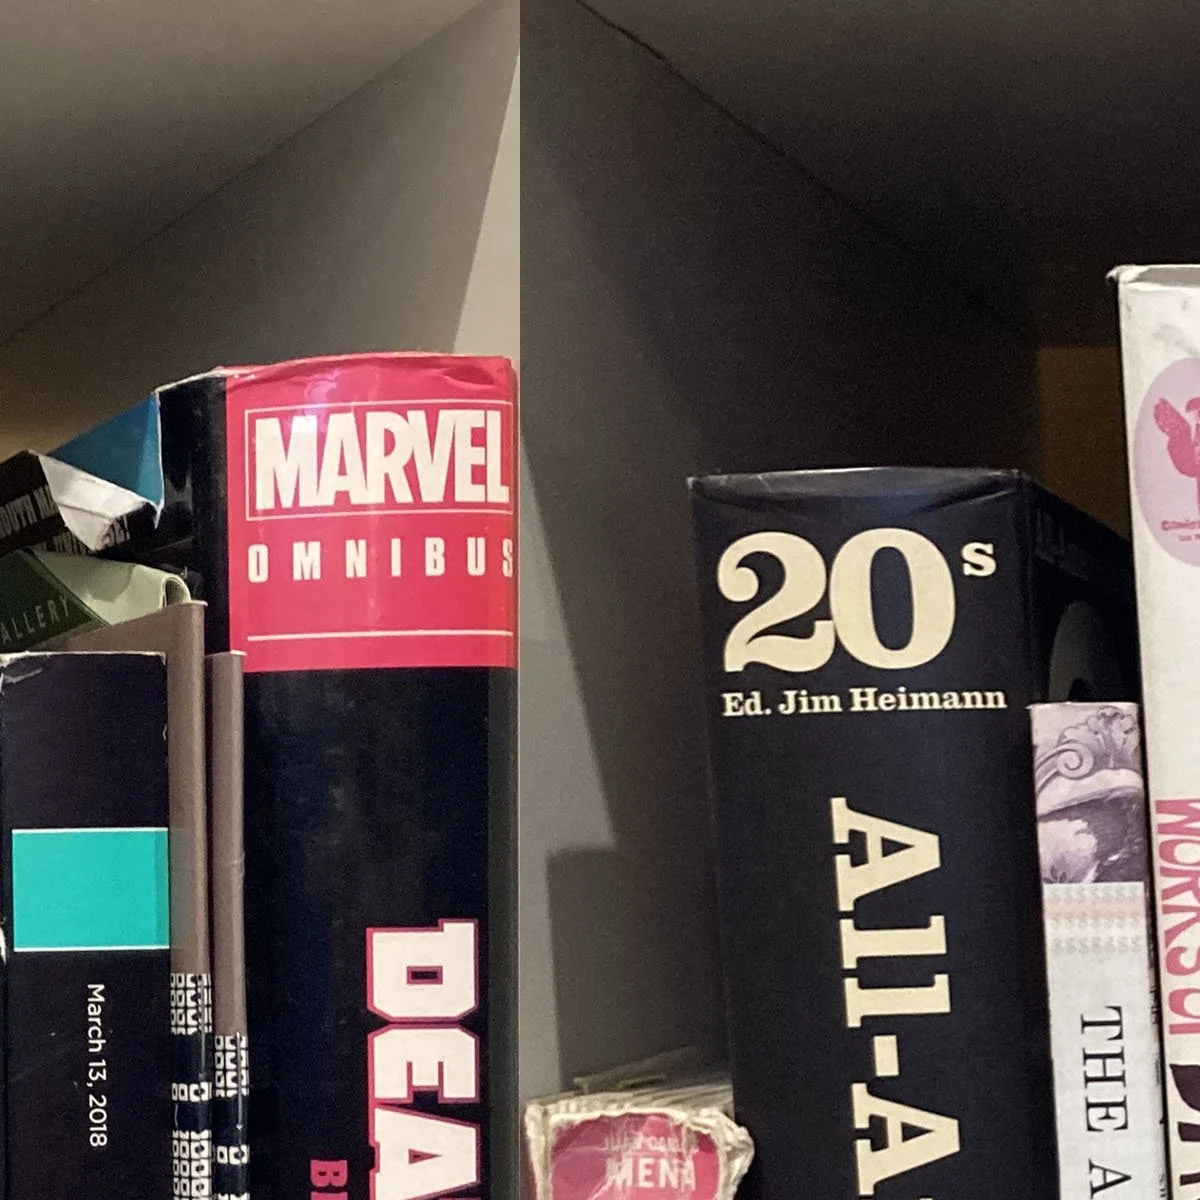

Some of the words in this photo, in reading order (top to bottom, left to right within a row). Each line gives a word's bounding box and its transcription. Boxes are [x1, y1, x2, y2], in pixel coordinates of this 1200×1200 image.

[254, 408, 511, 511] MARVEL
[247, 537, 513, 583] OMNIBUS
[721, 692, 772, 718] Ed.
[778, 688, 843, 714] Jim
[850, 685, 1008, 712] Heimann
[87, 983, 107, 1043] March
[87, 1047, 108, 1089] 13,
[1080, 1007, 1131, 1134] THE
[89, 1093, 109, 1148] 2018
